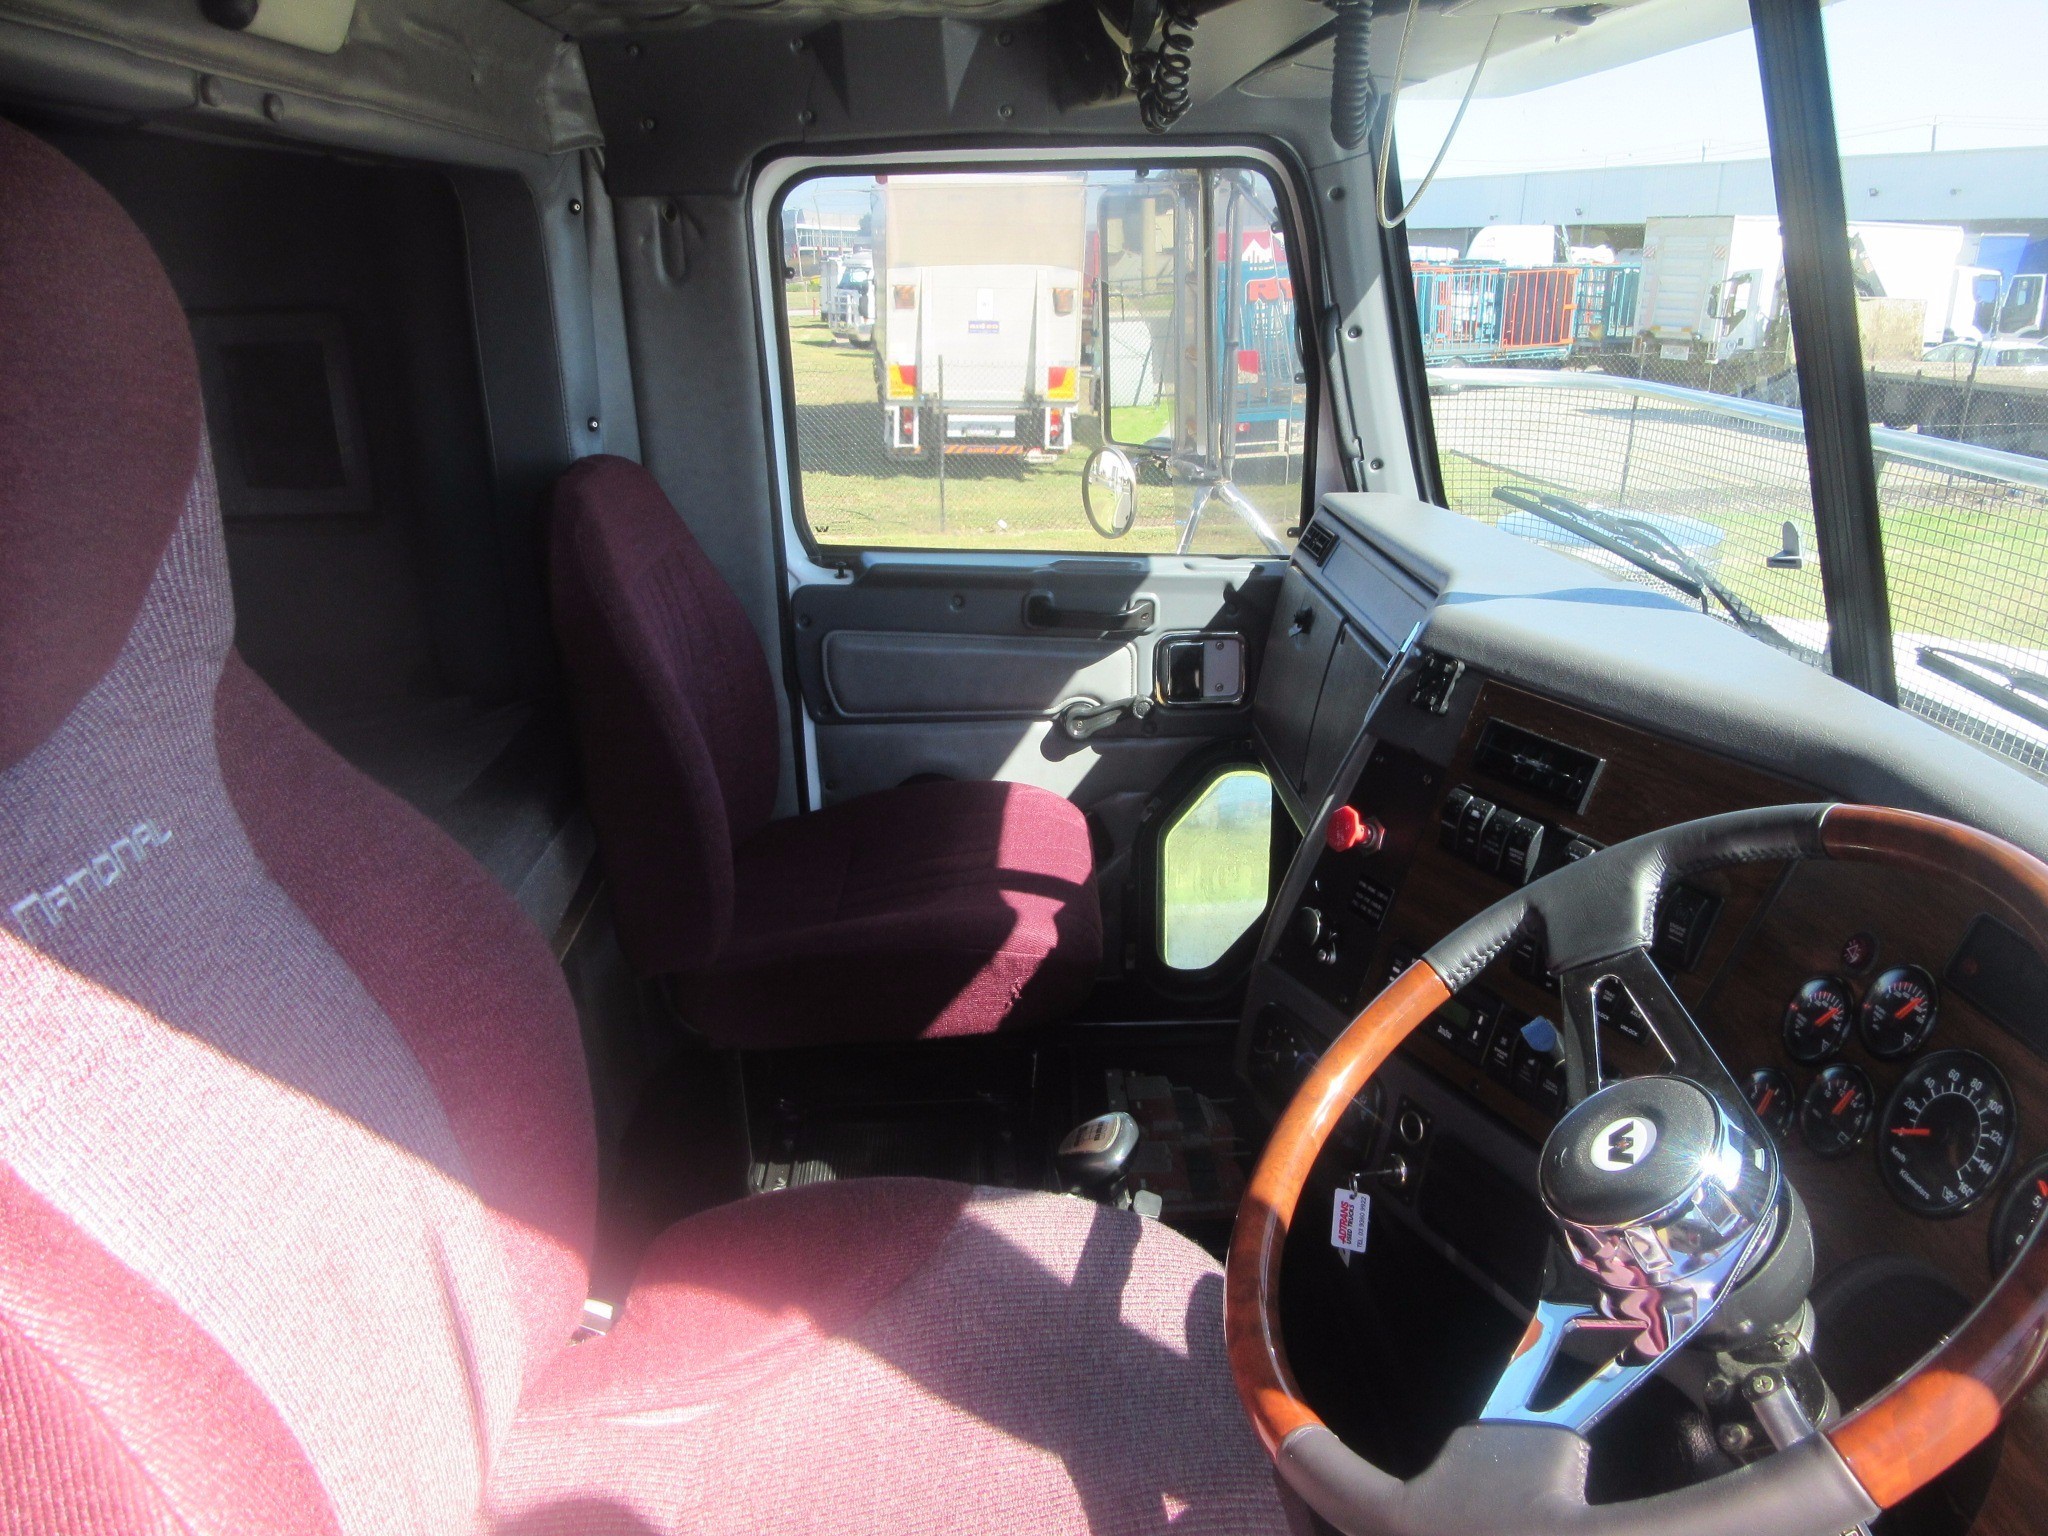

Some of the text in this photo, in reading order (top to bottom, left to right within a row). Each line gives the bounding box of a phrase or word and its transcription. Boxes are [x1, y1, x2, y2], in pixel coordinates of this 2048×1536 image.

[1948, 1069, 1960, 1081] 60
[1924, 1077, 1936, 1089] 40
[1970, 1078, 1983, 1091] 80
[1904, 1097, 1916, 1110] 20
[1987, 1100, 2004, 1115] 100
[1338, 1200, 1349, 1244] ADTRANS
